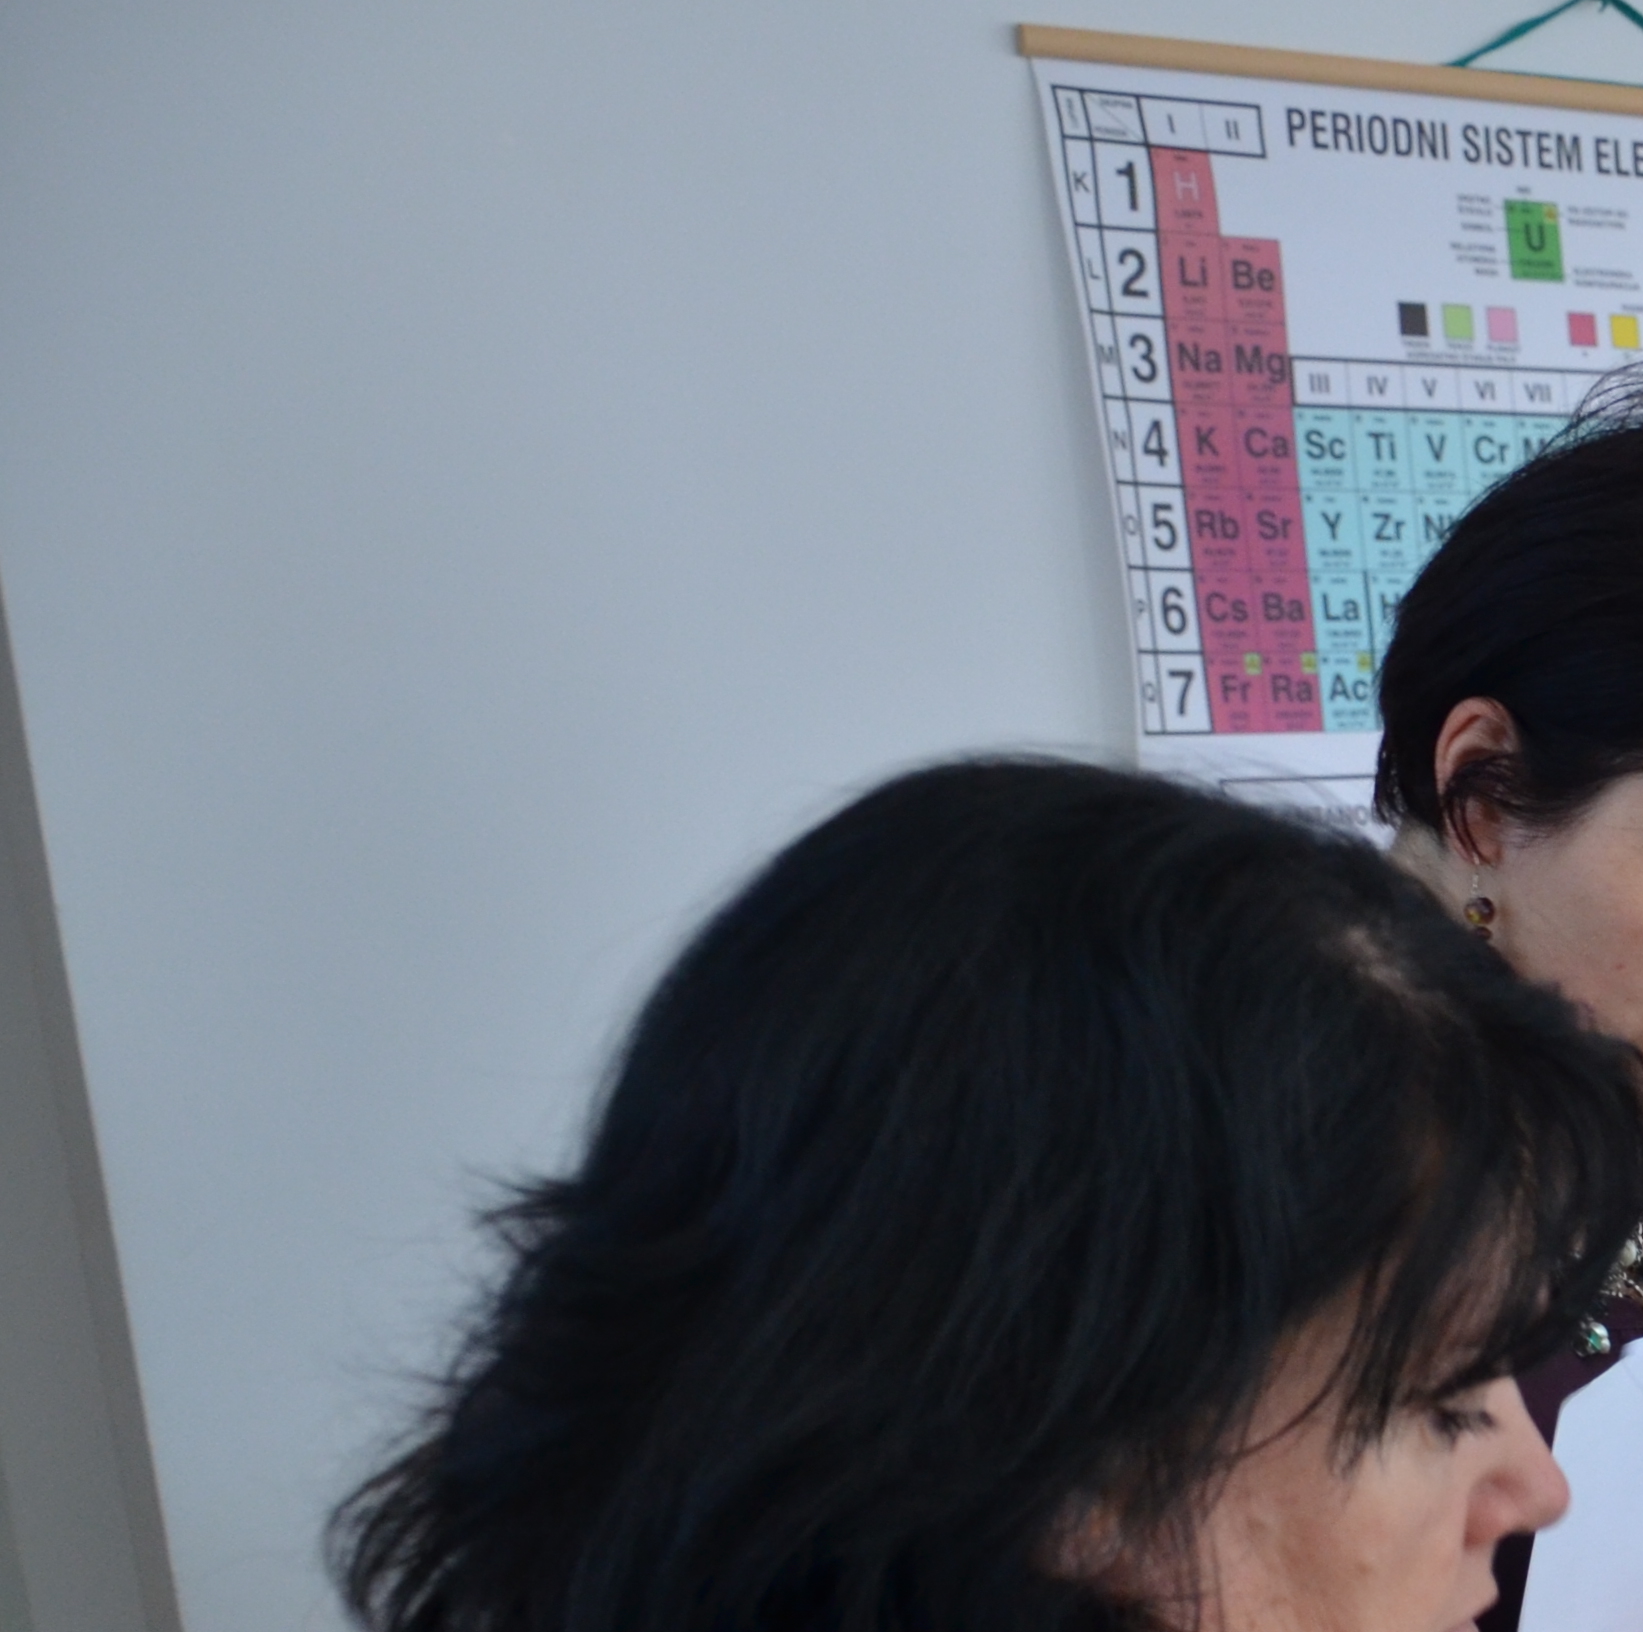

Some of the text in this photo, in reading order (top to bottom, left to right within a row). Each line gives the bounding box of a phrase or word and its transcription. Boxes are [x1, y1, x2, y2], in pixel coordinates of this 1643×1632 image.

[1286, 107, 1450, 161] PERIODNI
[1462, 124, 1583, 173] SISTEM
[1116, 161, 1139, 212] 1
[1174, 171, 1198, 201] H
[1524, 223, 1546, 252] U
[1118, 248, 1149, 298] 2
[1179, 256, 1208, 287] Li
[1232, 259, 1275, 291] Be
[1128, 333, 1157, 384] 3
[1177, 343, 1223, 374] Na
[1234, 344, 1286, 383] Mg
[1367, 376, 1388, 397] IV
[1142, 419, 1168, 467] 4
[1194, 426, 1219, 457] K
[1243, 427, 1290, 459] Ca
[1305, 429, 1346, 460] Sc
[1367, 432, 1397, 462] Ti
[1426, 433, 1447, 463] V
[1474, 434, 1510, 465] Cr
[1153, 504, 1178, 551] 5
[1195, 510, 1240, 540] Rb
[1256, 510, 1292, 540] Sr
[1321, 512, 1342, 540] Y
[1372, 512, 1406, 541] Zr
[1160, 587, 1188, 635] 6
[1206, 592, 1248, 622] Cs
[1262, 592, 1305, 622] Ba
[1322, 593, 1360, 621] La
[1168, 670, 1195, 716] 7
[1220, 674, 1253, 702] Fr
[1270, 674, 1313, 702] Ra
[1329, 674, 1369, 701] Ac
